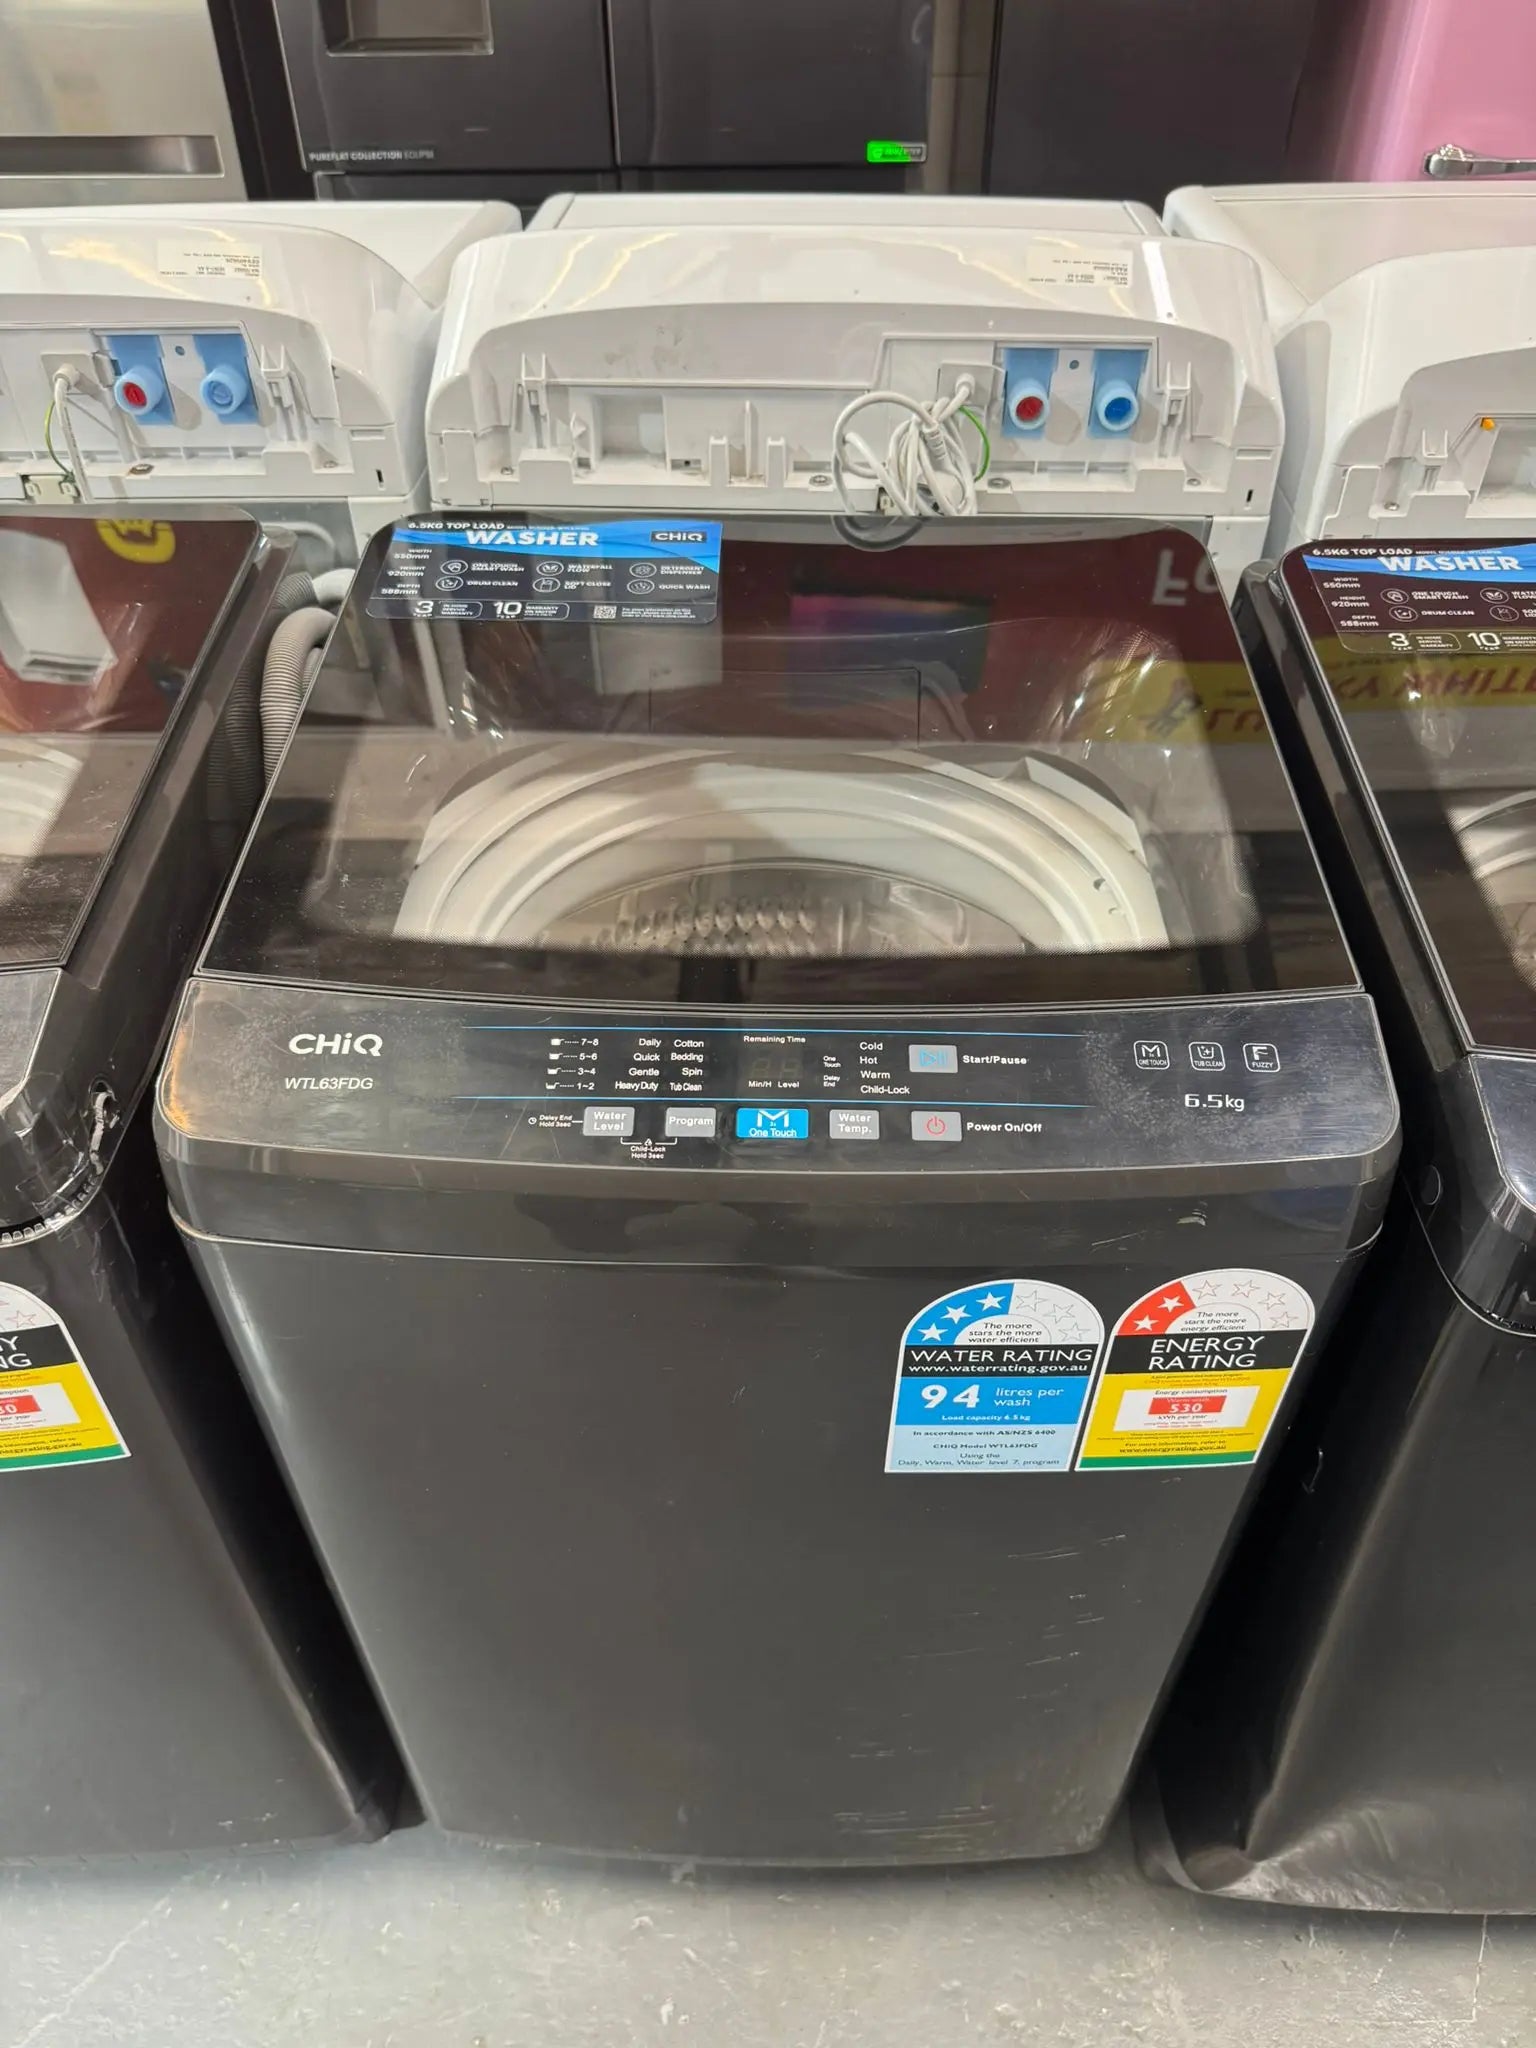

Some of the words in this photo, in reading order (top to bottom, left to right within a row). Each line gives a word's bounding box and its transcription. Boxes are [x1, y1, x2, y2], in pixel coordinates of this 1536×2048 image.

[466, 530, 599, 546] WASHER
[1312, 548, 1349, 556] 6.5KG
[1351, 548, 1376, 556] TOP
[1376, 556, 1524, 572] WASHER
[414, 600, 434, 614] 3
[494, 601, 523, 615] 10
[1388, 633, 1409, 647] 3
[1467, 632, 1501, 647] 10
[288, 1032, 384, 1057] CHiQ
[638, 1038, 662, 1047] Daily
[673, 1039, 704, 1048] Cotton
[743, 1035, 786, 1044] Remaining
[859, 1041, 884, 1051] Cold
[633, 1052, 661, 1062] Quick
[670, 1052, 704, 1063] Bedding
[859, 1056, 878, 1065] Hot
[962, 1055, 1027, 1065] Start/Pause
[628, 1067, 660, 1076] Gentle
[681, 1067, 703, 1077] Spin
[860, 1070, 890, 1079] Warm
[284, 1077, 374, 1090] WTL63FDG
[615, 1081, 640, 1091] Heavy
[641, 1081, 660, 1091] Duty
[669, 1082, 682, 1091] Tub
[683, 1082, 703, 1091] Clean
[777, 1081, 800, 1089] Level
[860, 1085, 911, 1095] Child-Lock
[1184, 1093, 1245, 1112] 6.5kg
[539, 1114, 559, 1122] Delay
[593, 1111, 627, 1121] Water
[838, 1113, 872, 1123] Water
[593, 1120, 624, 1131] Level
[668, 1116, 713, 1127] Program
[838, 1123, 873, 1134] Temp.
[966, 1122, 1002, 1132] Power
[1004, 1122, 1042, 1132] On/Off
[748, 1128, 769, 1137] One
[770, 1128, 797, 1137] Touch
[630, 1145, 666, 1153] Child-Lock
[983, 1322, 1003, 1330] The
[1150, 1335, 1265, 1354] ENERGY
[911, 1349, 995, 1362] WATER
[1002, 1349, 1094, 1362] RATING
[1147, 1353, 1256, 1371] RATING
[908, 1363, 1088, 1375] www.waterrating.gov.au
[995, 1387, 1033, 1397] litres
[1037, 1388, 1064, 1400] per
[993, 1397, 1031, 1406] wash
[1168, 1403, 1203, 1413] 530
[1119, 1444, 1226, 1453] www.energyrating.gov.au
[898, 1459, 923, 1467] Daily,
